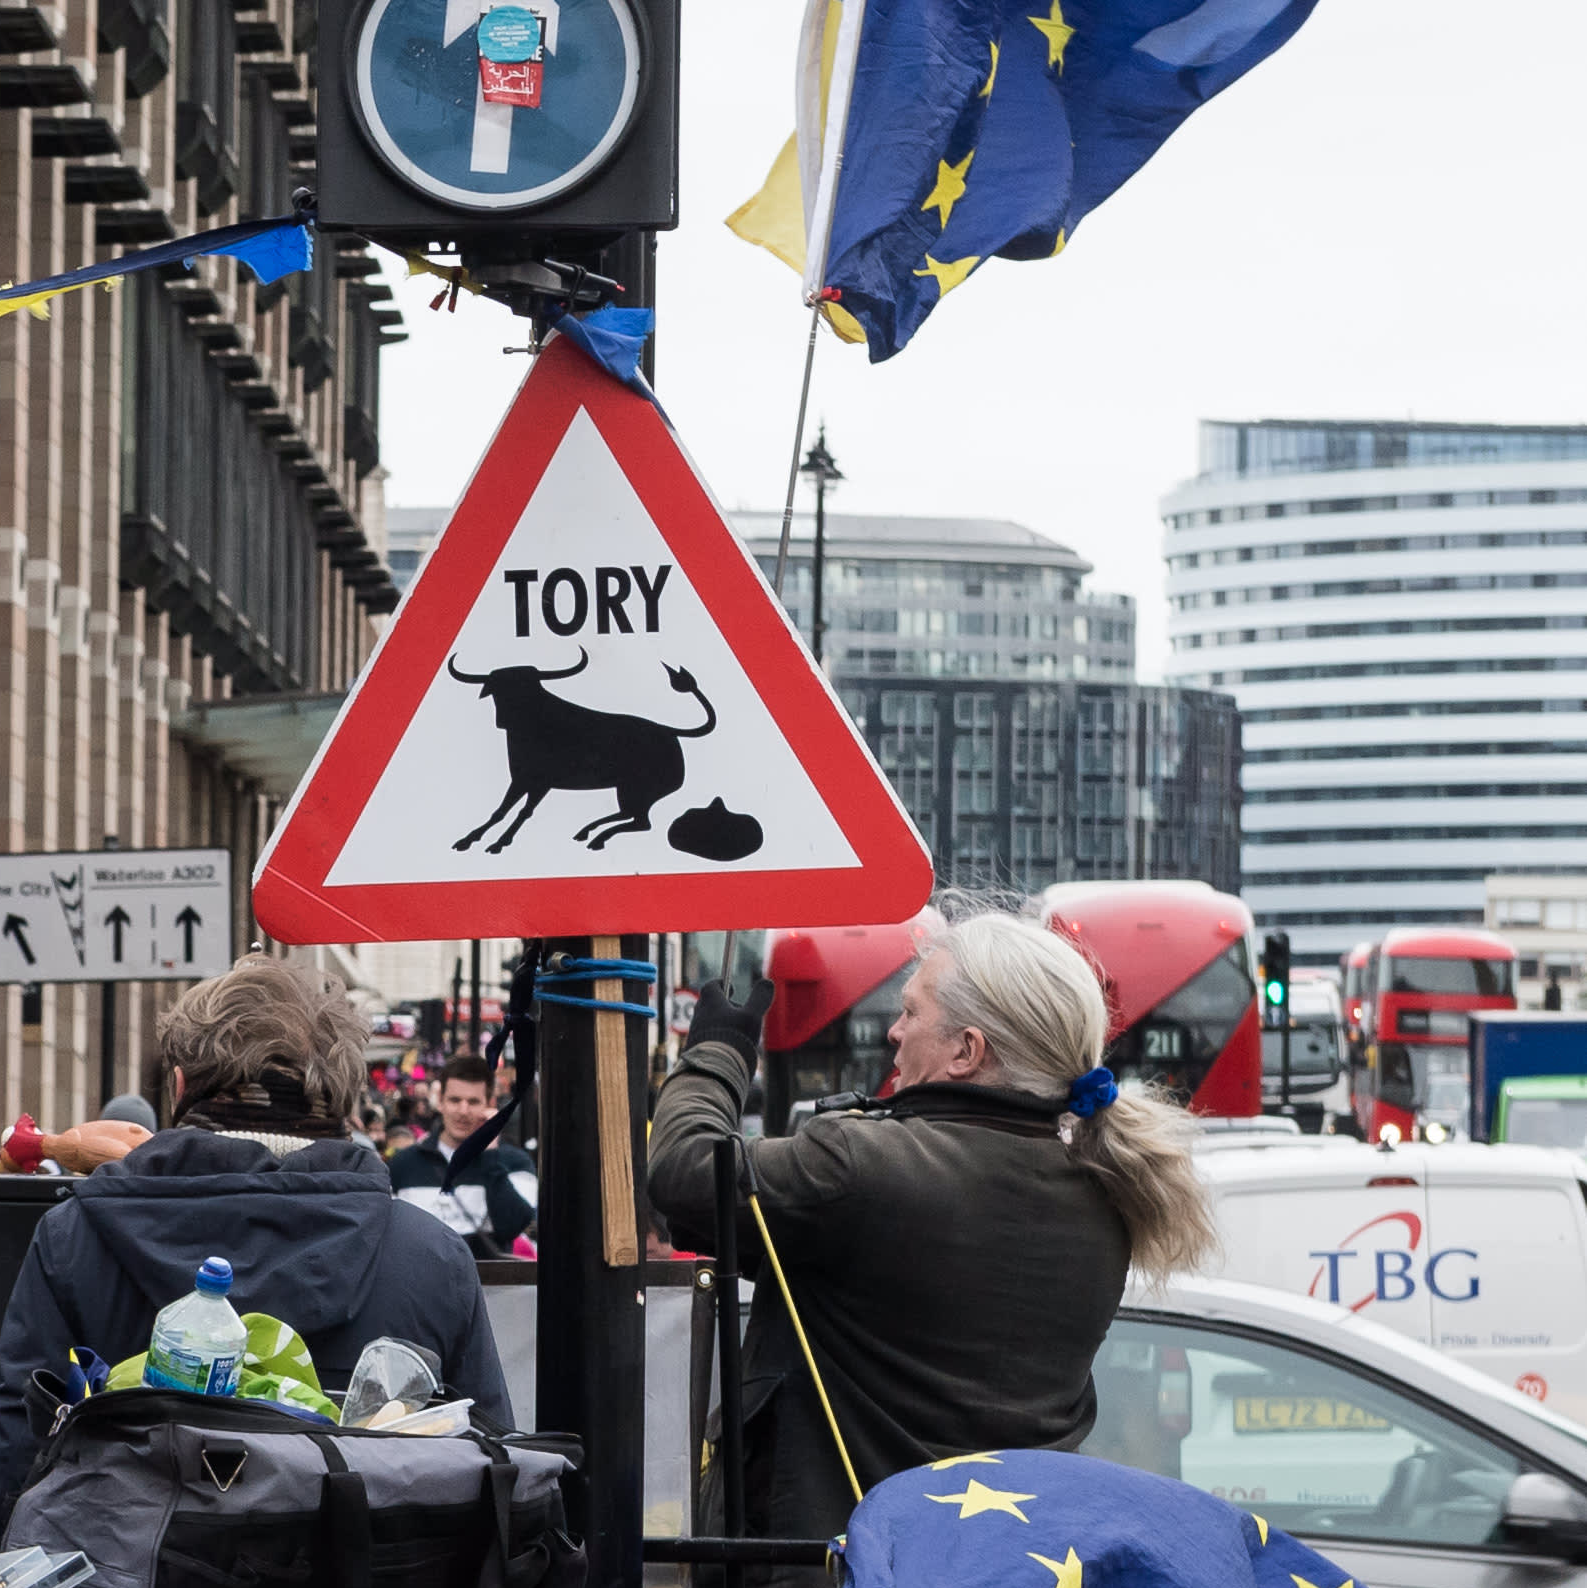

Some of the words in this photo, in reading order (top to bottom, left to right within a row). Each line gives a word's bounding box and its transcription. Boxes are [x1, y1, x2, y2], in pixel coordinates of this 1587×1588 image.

[504, 564, 672, 638] TORY
[94, 867, 166, 883] Waterloo
[171, 864, 216, 881] A302
[18, 880, 52, 898] City
[1145, 1031, 1182, 1058] 211
[1309, 1248, 1480, 1304] TBG
